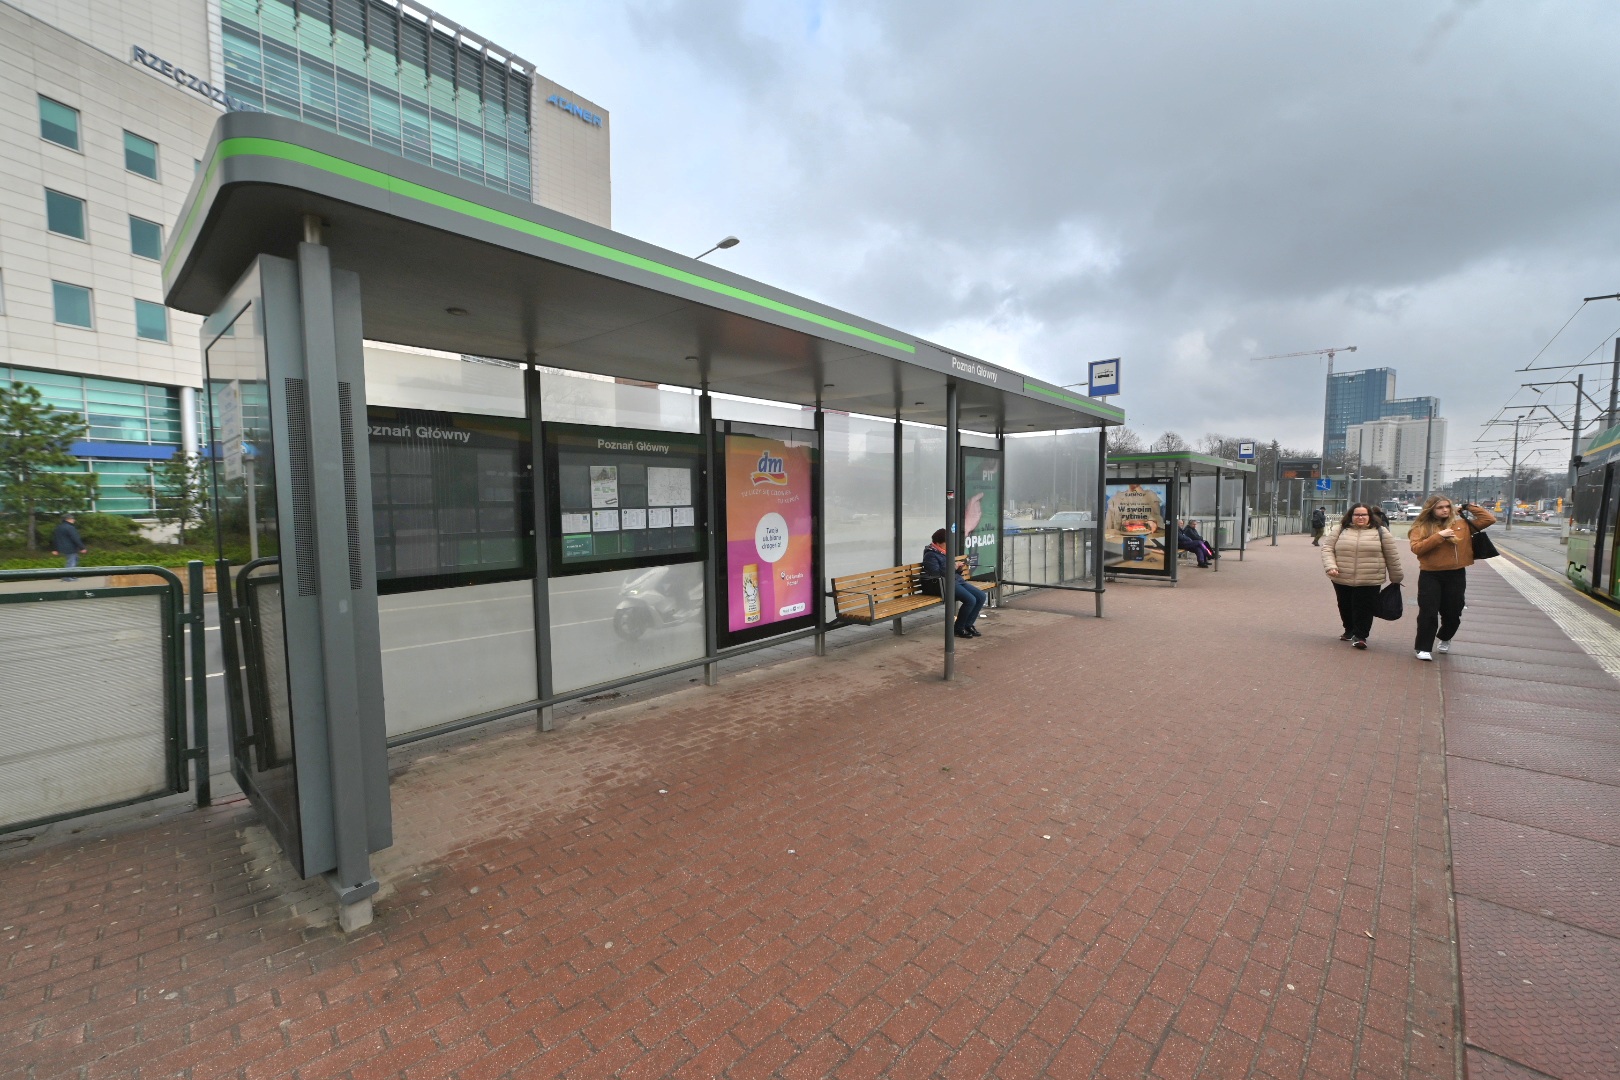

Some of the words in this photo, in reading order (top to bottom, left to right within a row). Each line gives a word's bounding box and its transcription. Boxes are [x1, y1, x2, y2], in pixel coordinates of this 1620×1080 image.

[546, 95, 602, 128] ATANER
[952, 357, 976, 375] Poznań
[976, 365, 998, 383] Główny
[367, 425, 411, 438] oznań
[416, 426, 470, 443] Główny
[597, 439, 634, 451] Poznań
[636, 441, 669, 455] Główny
[758, 451, 783, 473] dm
[982, 470, 994, 481] PIT
[1121, 512, 1148, 520] rytmie
[1126, 505, 1152, 513] swoim
[965, 533, 995, 548] OPŁACA
